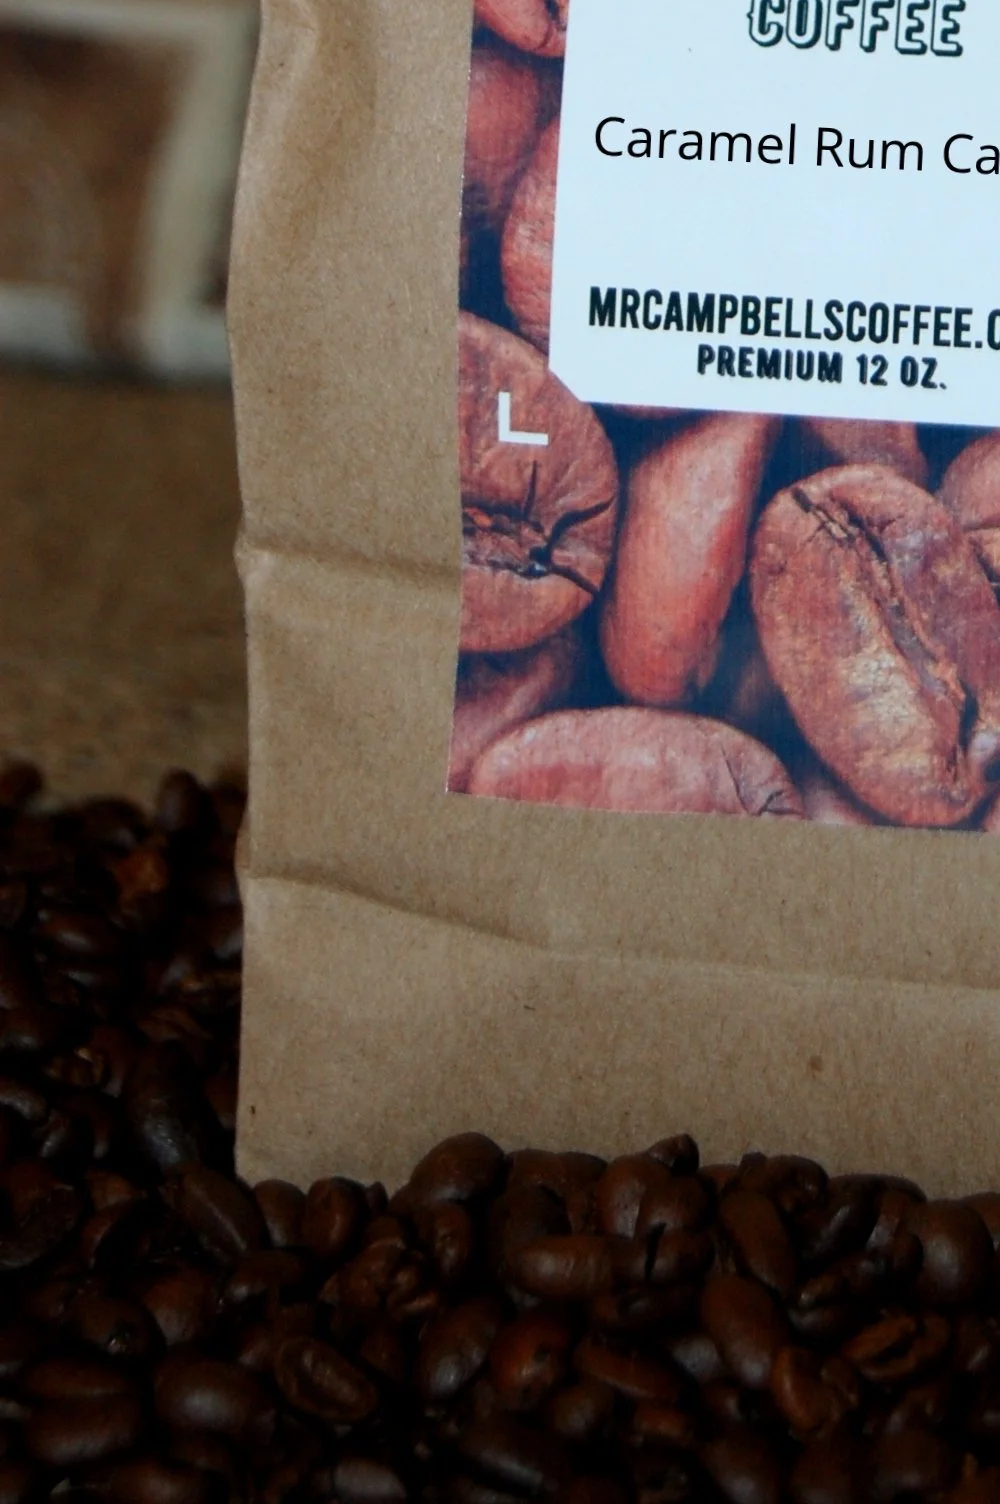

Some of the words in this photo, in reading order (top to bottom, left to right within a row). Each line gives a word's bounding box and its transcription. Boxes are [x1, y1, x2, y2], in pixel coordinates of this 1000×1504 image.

[594, 116, 797, 165] Caramel
[815, 126, 924, 171] Rum
[697, 344, 843, 384] PREMIUM
[856, 354, 888, 386] 12
[899, 356, 947, 390] OZ.
